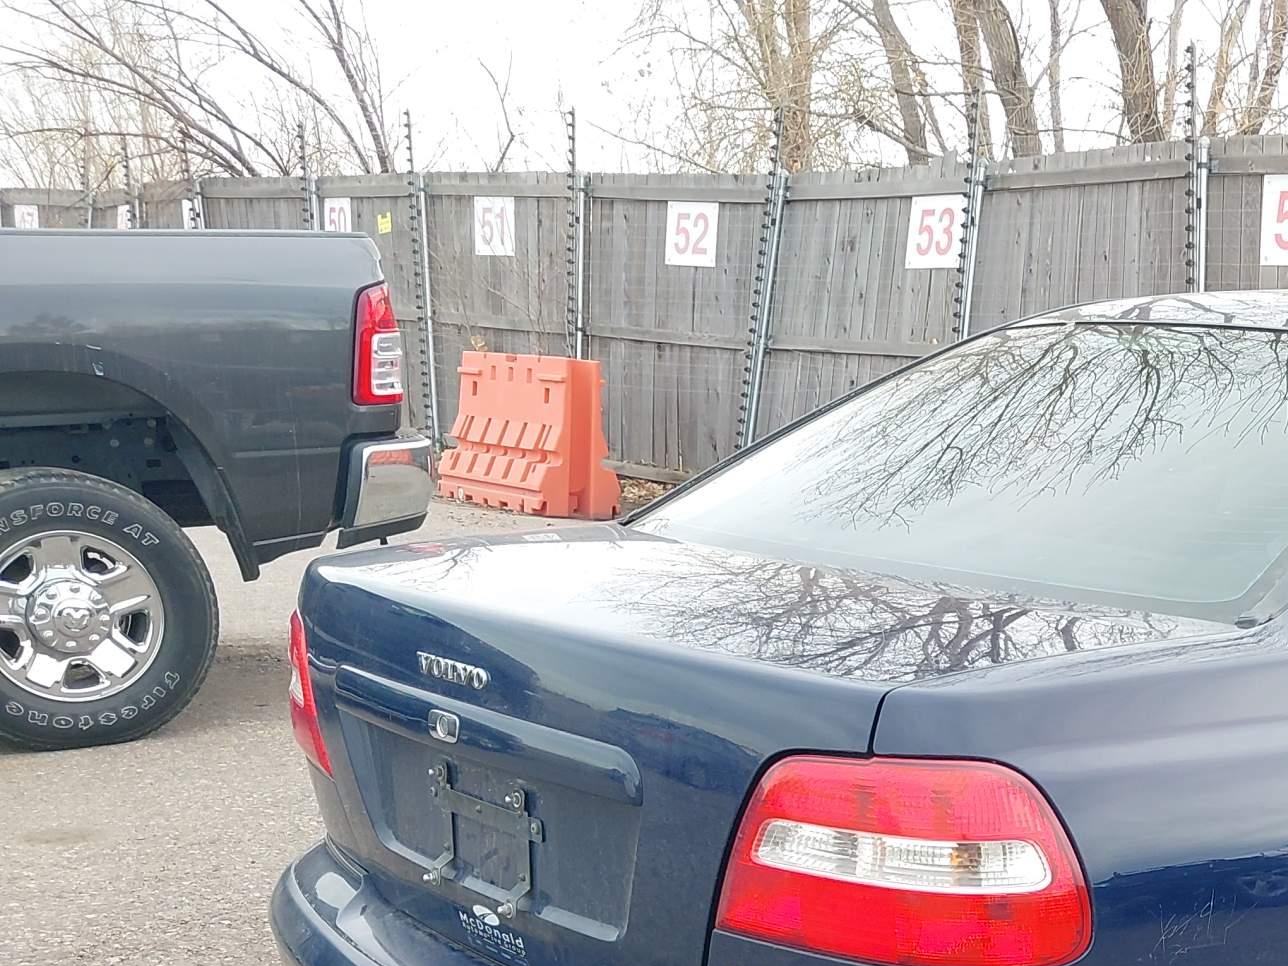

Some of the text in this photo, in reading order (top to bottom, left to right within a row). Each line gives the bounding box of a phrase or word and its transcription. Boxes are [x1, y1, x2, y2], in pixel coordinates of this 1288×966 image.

[329, 207, 347, 232] 50
[481, 207, 506, 246] 51
[673, 212, 709, 255] 52
[915, 207, 955, 256] 53
[122, 523, 160, 546] AT
[416, 651, 489, 690] VOLVO
[459, 911, 524, 949] McDonald
